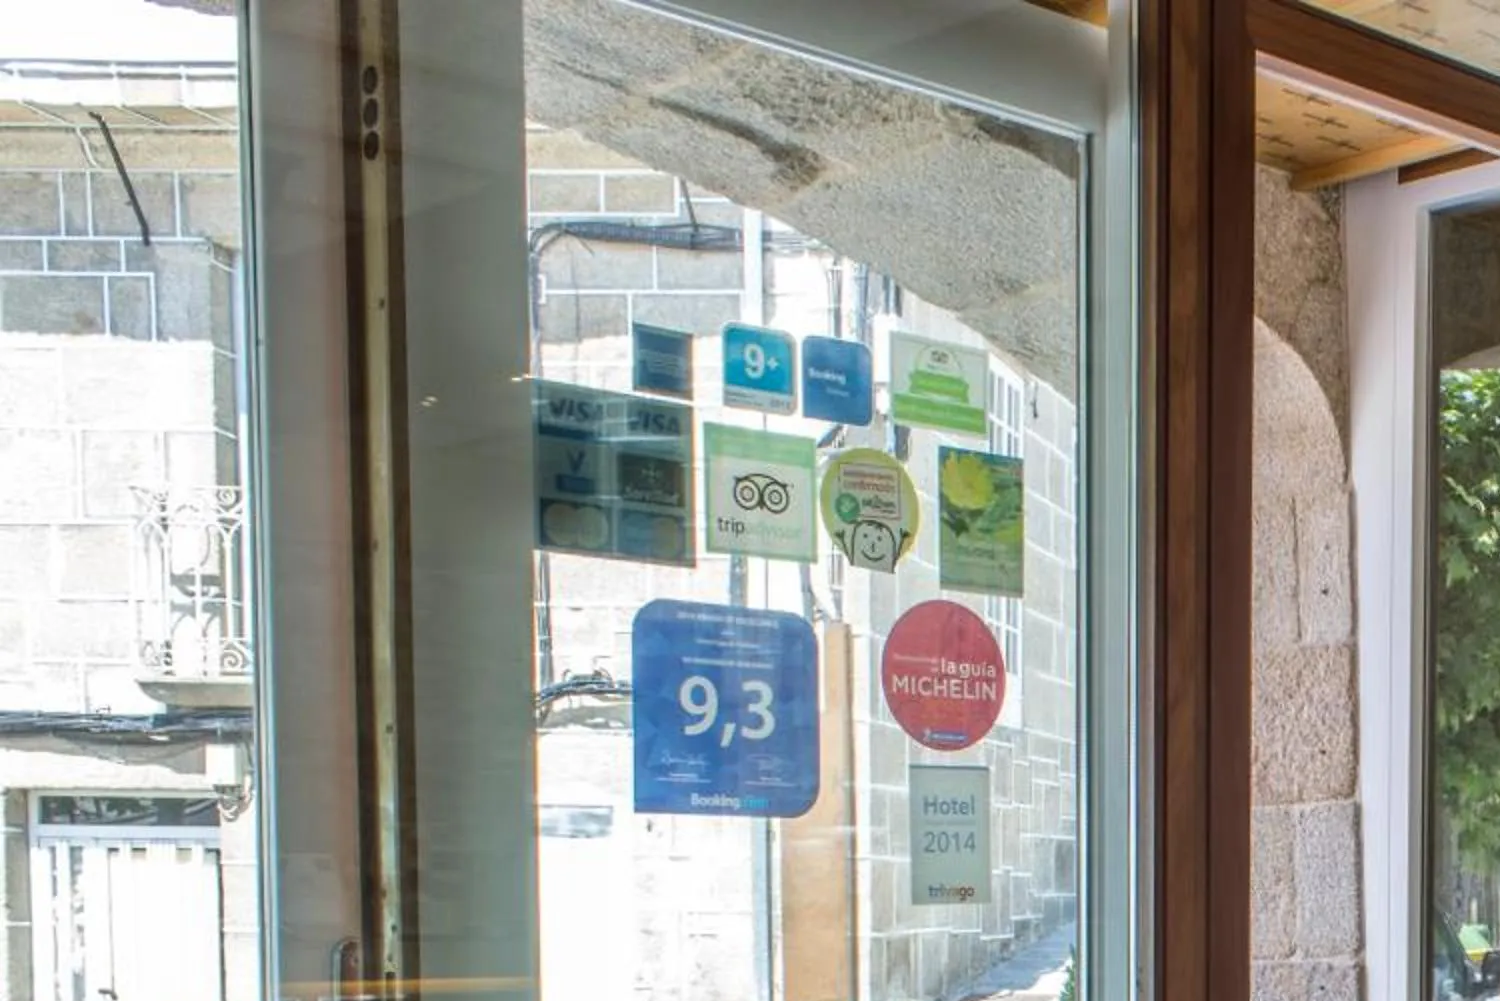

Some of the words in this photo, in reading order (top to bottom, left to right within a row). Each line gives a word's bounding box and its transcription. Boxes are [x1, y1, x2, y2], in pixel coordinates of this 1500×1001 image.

[743, 343, 779, 379] 9+
[941, 657, 957, 675] la
[891, 674, 997, 701] MICHELIN
[679, 674, 776, 747] 9,3
[923, 794, 976, 816] Hotel
[923, 831, 977, 854] 2014
